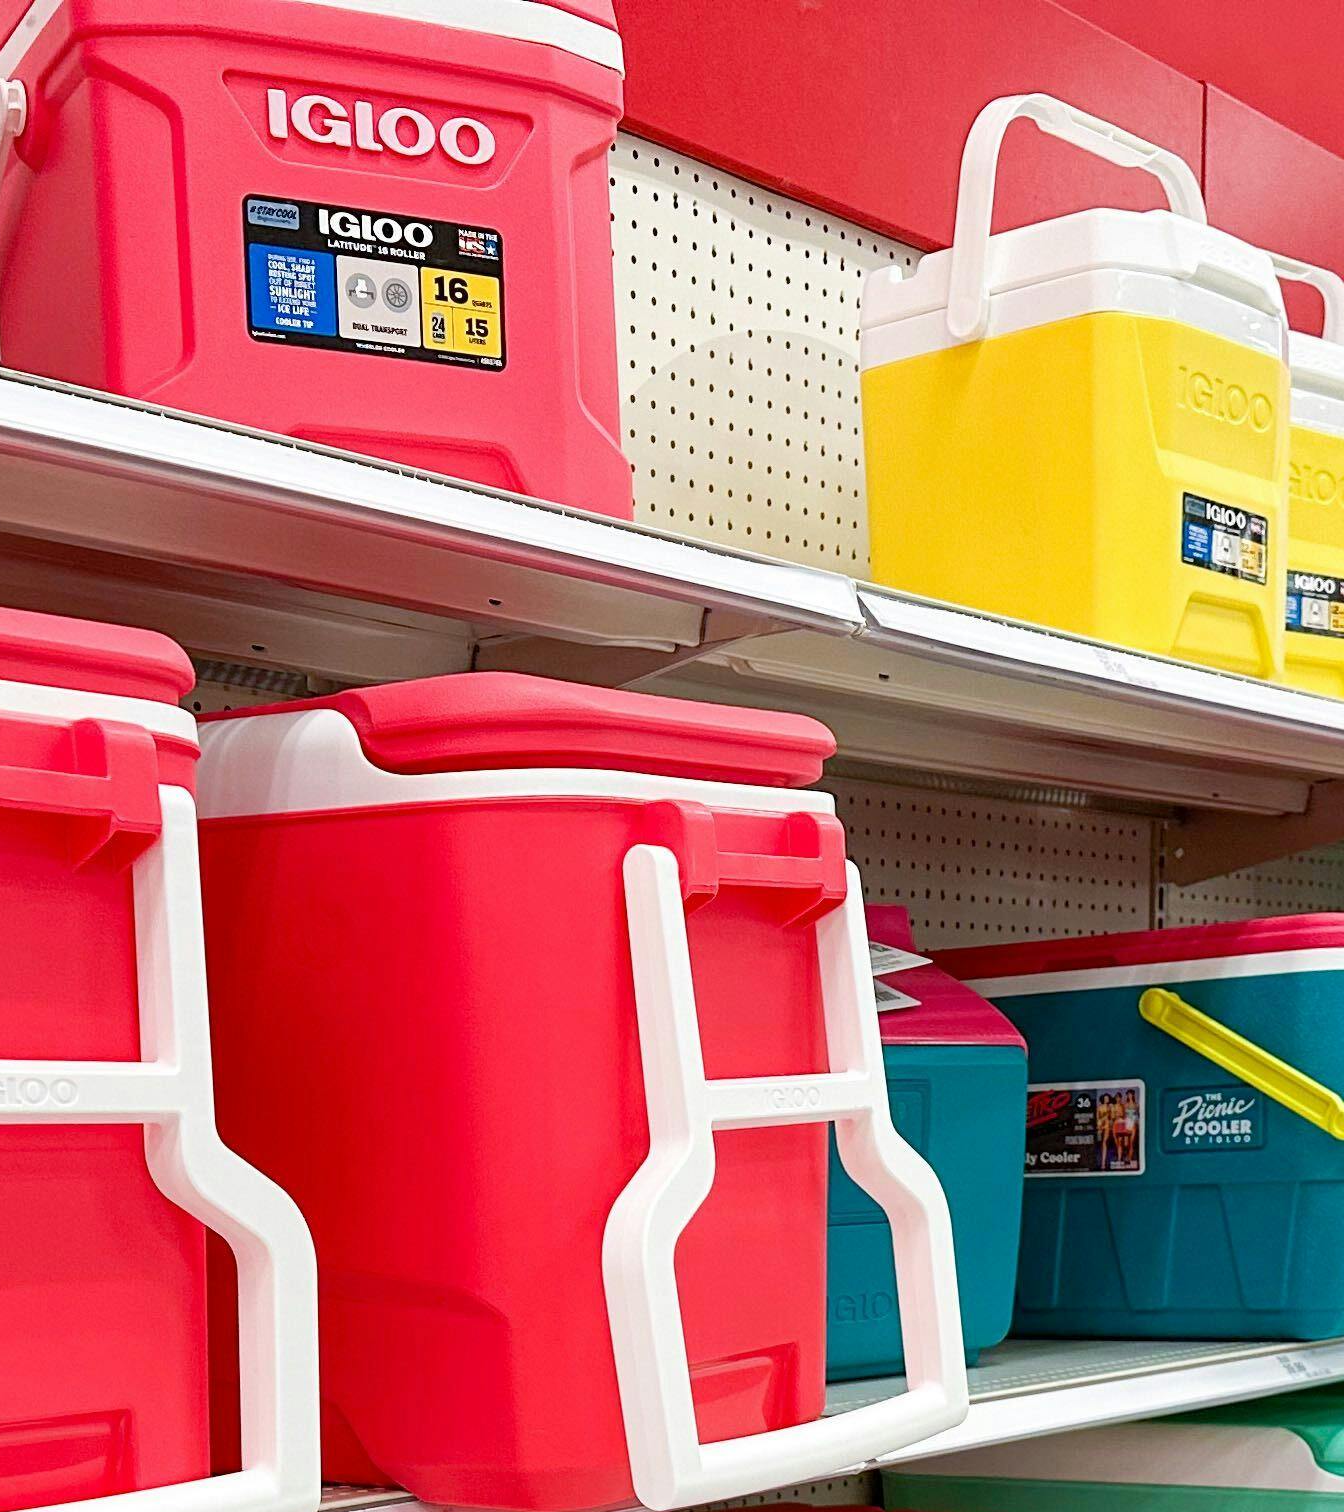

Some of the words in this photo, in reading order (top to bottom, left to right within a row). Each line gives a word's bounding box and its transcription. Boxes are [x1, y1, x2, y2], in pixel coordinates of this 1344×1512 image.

[267, 88, 496, 165] IGLOO
[318, 208, 434, 249] IGLOO
[390, 247, 426, 261] ROLLER
[269, 286, 316, 301] SUNLIGHT
[434, 275, 469, 305] 16
[432, 316, 446, 332] 24
[465, 317, 489, 338] 15
[1178, 365, 1273, 433] IGLOO
[1206, 503, 1246, 529] IGLOO
[1294, 574, 1336, 594] IGLOO
[1172, 1096, 1255, 1137] Picnic
[1184, 1120, 1251, 1136] COOLER
[1040, 1151, 1081, 1163] Cooler
[834, 1291, 893, 1323] GLO
